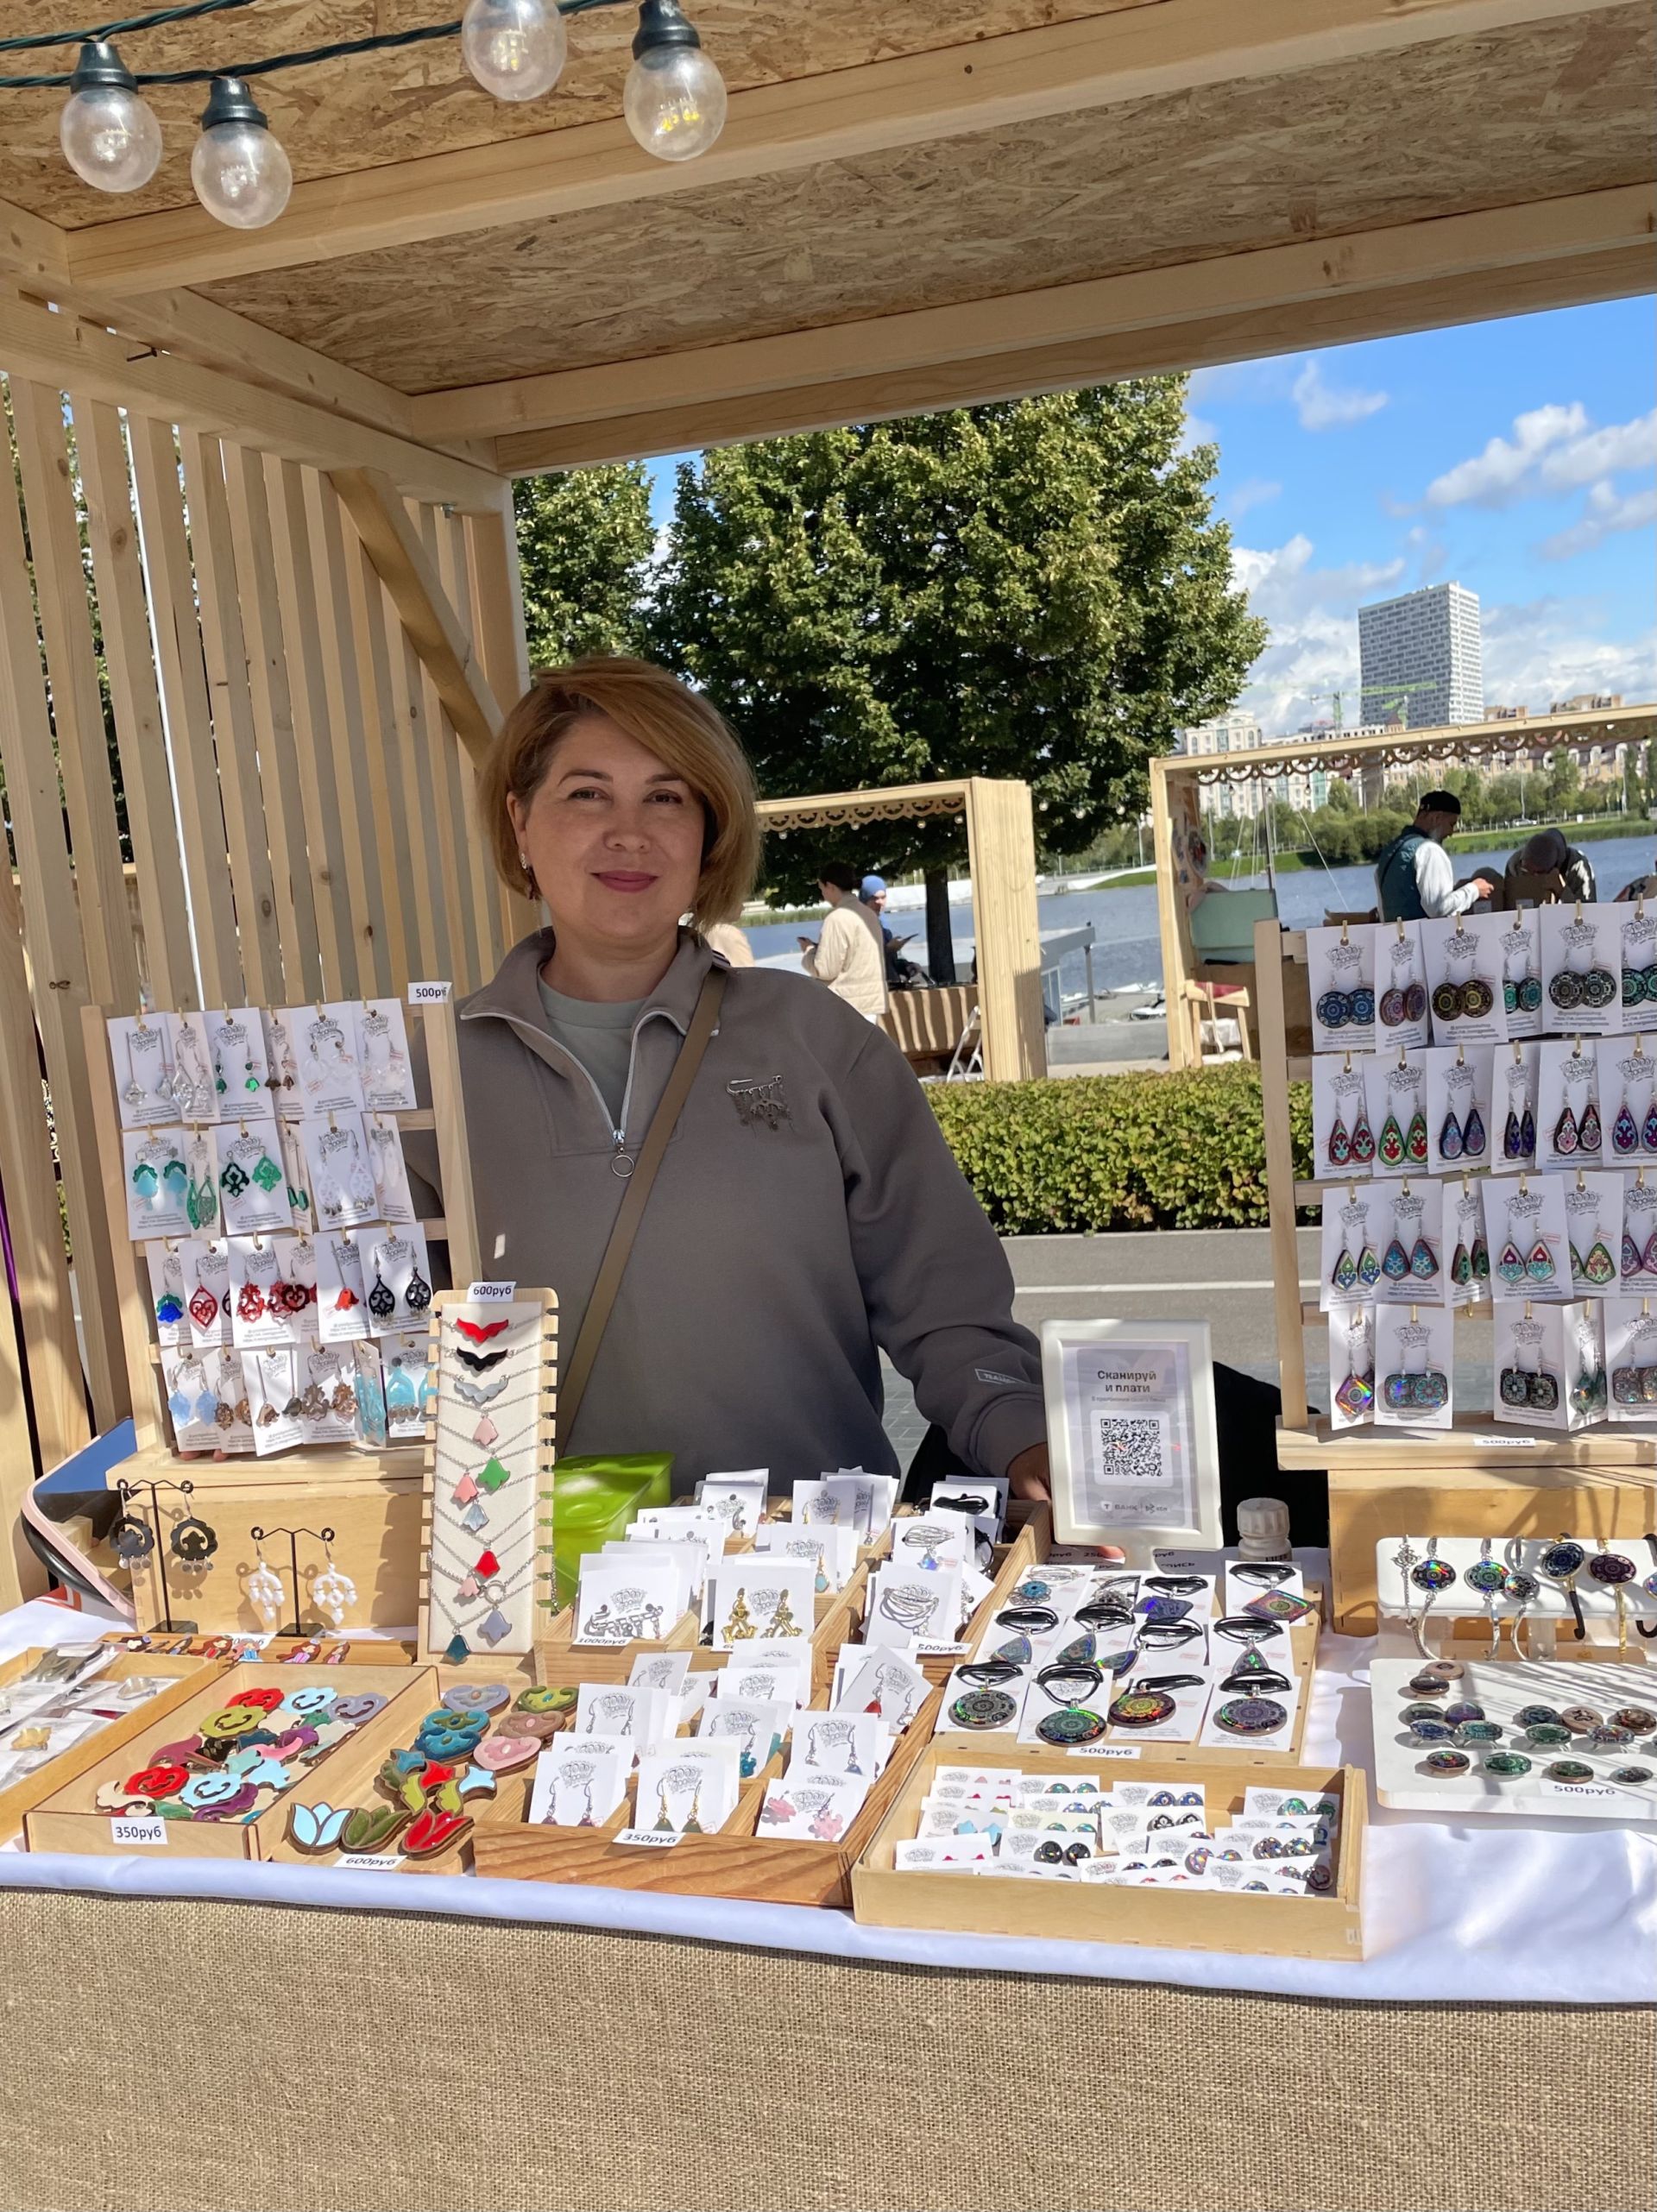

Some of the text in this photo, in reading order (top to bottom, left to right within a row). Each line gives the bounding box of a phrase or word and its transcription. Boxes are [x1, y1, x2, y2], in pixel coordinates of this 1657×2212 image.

[473, 1285, 513, 1297] 600руб
[1097, 1370, 1157, 1383] Сканируй
[917, 1643, 964, 1652] 500руб
[1079, 1747, 1133, 1756] 500руб
[1553, 1785, 1616, 1796] 500руб
[115, 1825, 162, 1840] 350руб
[622, 1833, 678, 1844] 350руб
[346, 1856, 398, 1866] 600руб
